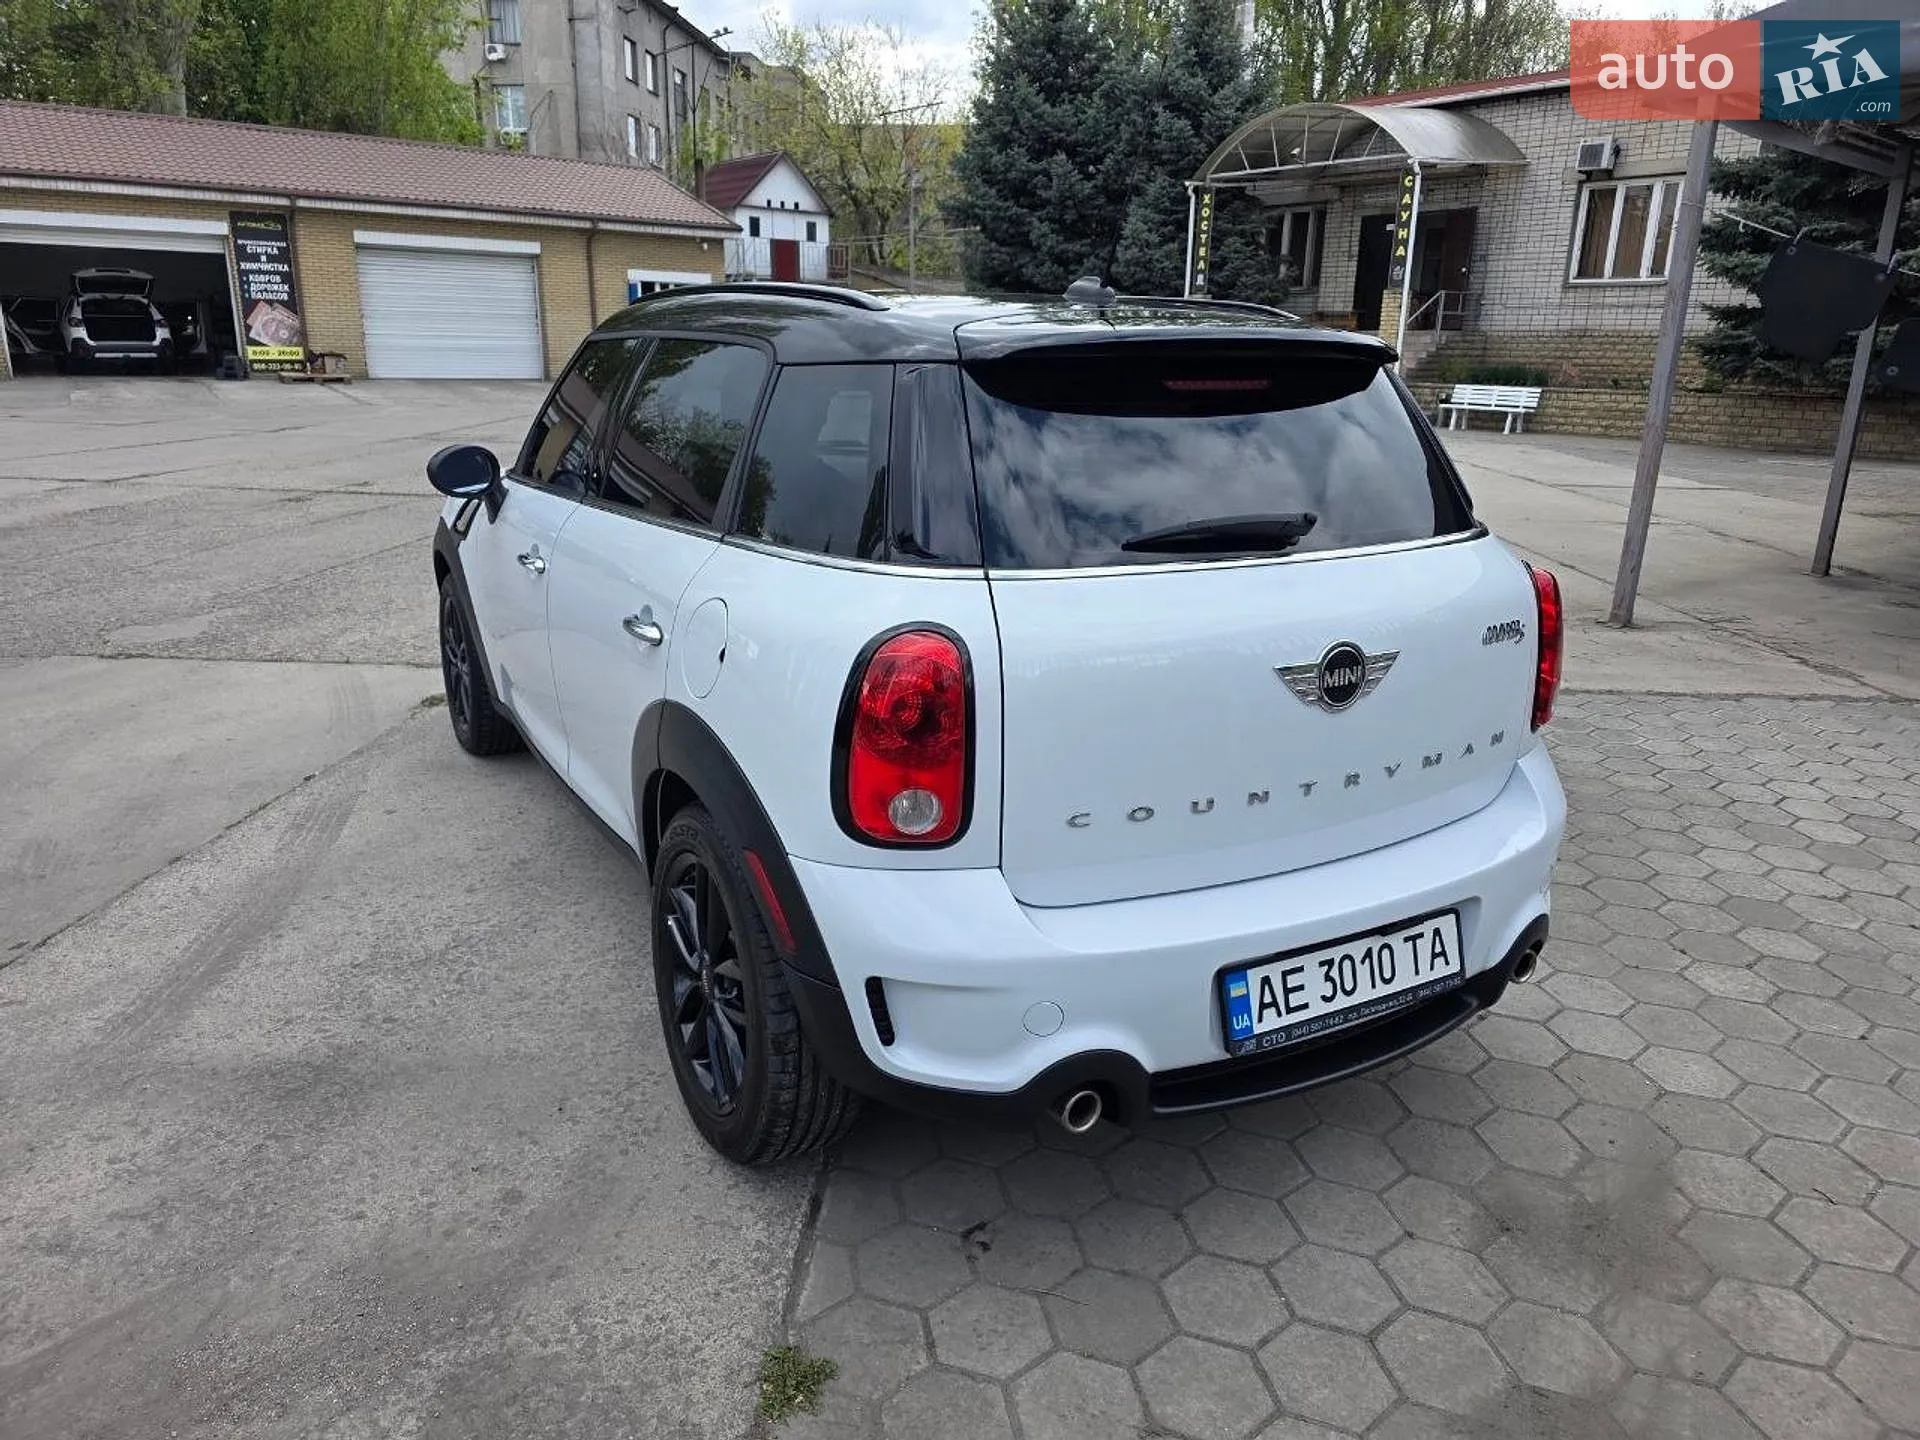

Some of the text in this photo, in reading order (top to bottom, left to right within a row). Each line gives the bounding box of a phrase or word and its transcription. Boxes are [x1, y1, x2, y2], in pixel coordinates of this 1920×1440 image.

[1395, 175, 1414, 257] САУНА
[1197, 193, 1212, 270] ХОСТЕЛ
[246, 245, 279, 255] СТИРКА
[240, 262, 290, 272] ХИМЧИСТКА
[248, 274, 282, 283] КОВРОВ
[250, 283, 290, 292] ДОРОЖЕК
[250, 291, 289, 301] ПАЛАСОВ
[1323, 665, 1363, 688] MINI
[1065, 729, 1505, 829] COUNTRYMAN
[1257, 964, 1310, 1024] AE
[1318, 941, 1397, 1004] 3010
[1403, 926, 1451, 976] TA
[1232, 1014, 1251, 1031] UA
